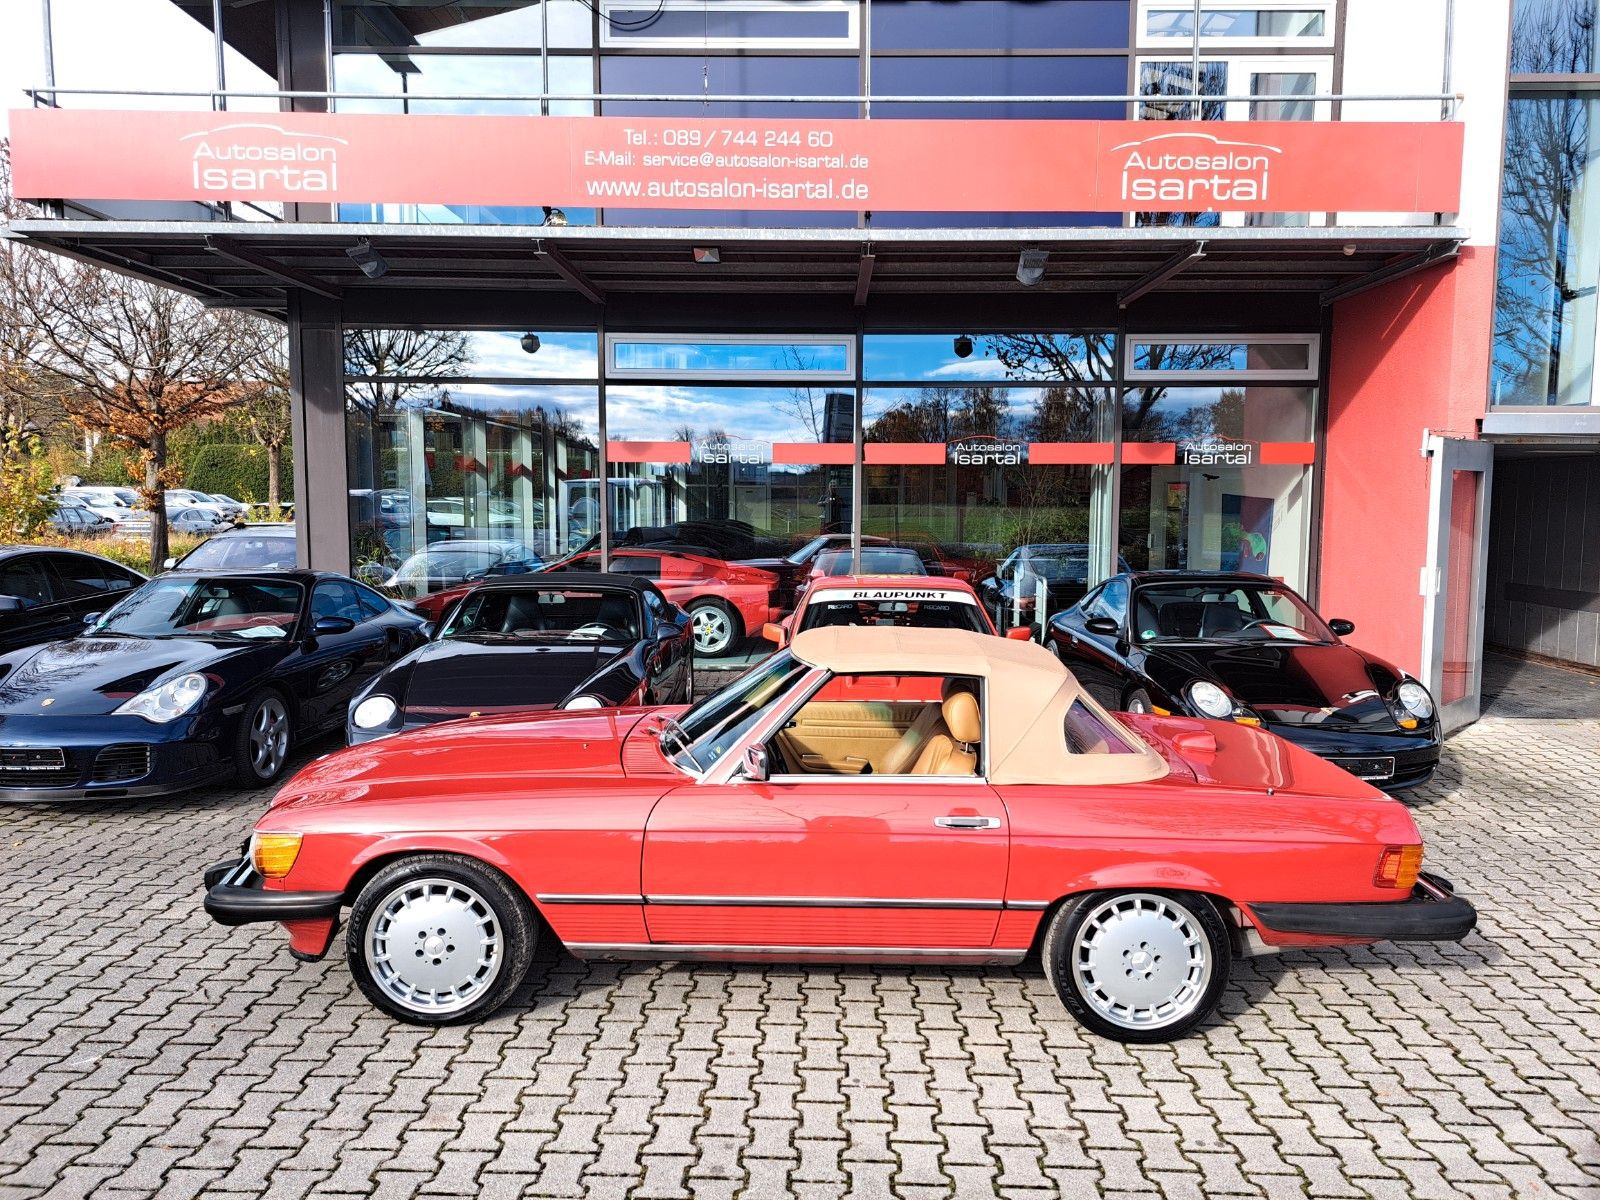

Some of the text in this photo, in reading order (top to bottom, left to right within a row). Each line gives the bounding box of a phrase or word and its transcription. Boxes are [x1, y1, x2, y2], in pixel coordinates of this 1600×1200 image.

[662, 129, 701, 147] 089
[703, 130, 717, 147] /
[721, 129, 758, 147] 744
[764, 130, 801, 147] 244
[807, 130, 833, 148] 60
[193, 141, 337, 161] Autosalon
[583, 151, 869, 169] E-Mail: service@autosalon-isartal.de
[1123, 151, 1269, 170] Autosalon
[192, 160, 337, 191] Isartal
[586, 177, 869, 200] www.autosalon-isartal.de
[1121, 171, 1268, 201] Isartal
[699, 441, 764, 451] Autosalon
[955, 442, 1021, 452] Autosalon
[1185, 442, 1252, 451] Autosalon
[699, 450, 764, 464] Isartal
[954, 451, 1021, 465] Isartal
[1183, 451, 1252, 465] Isartal
[852, 591, 948, 600] BLAUPUNKT
